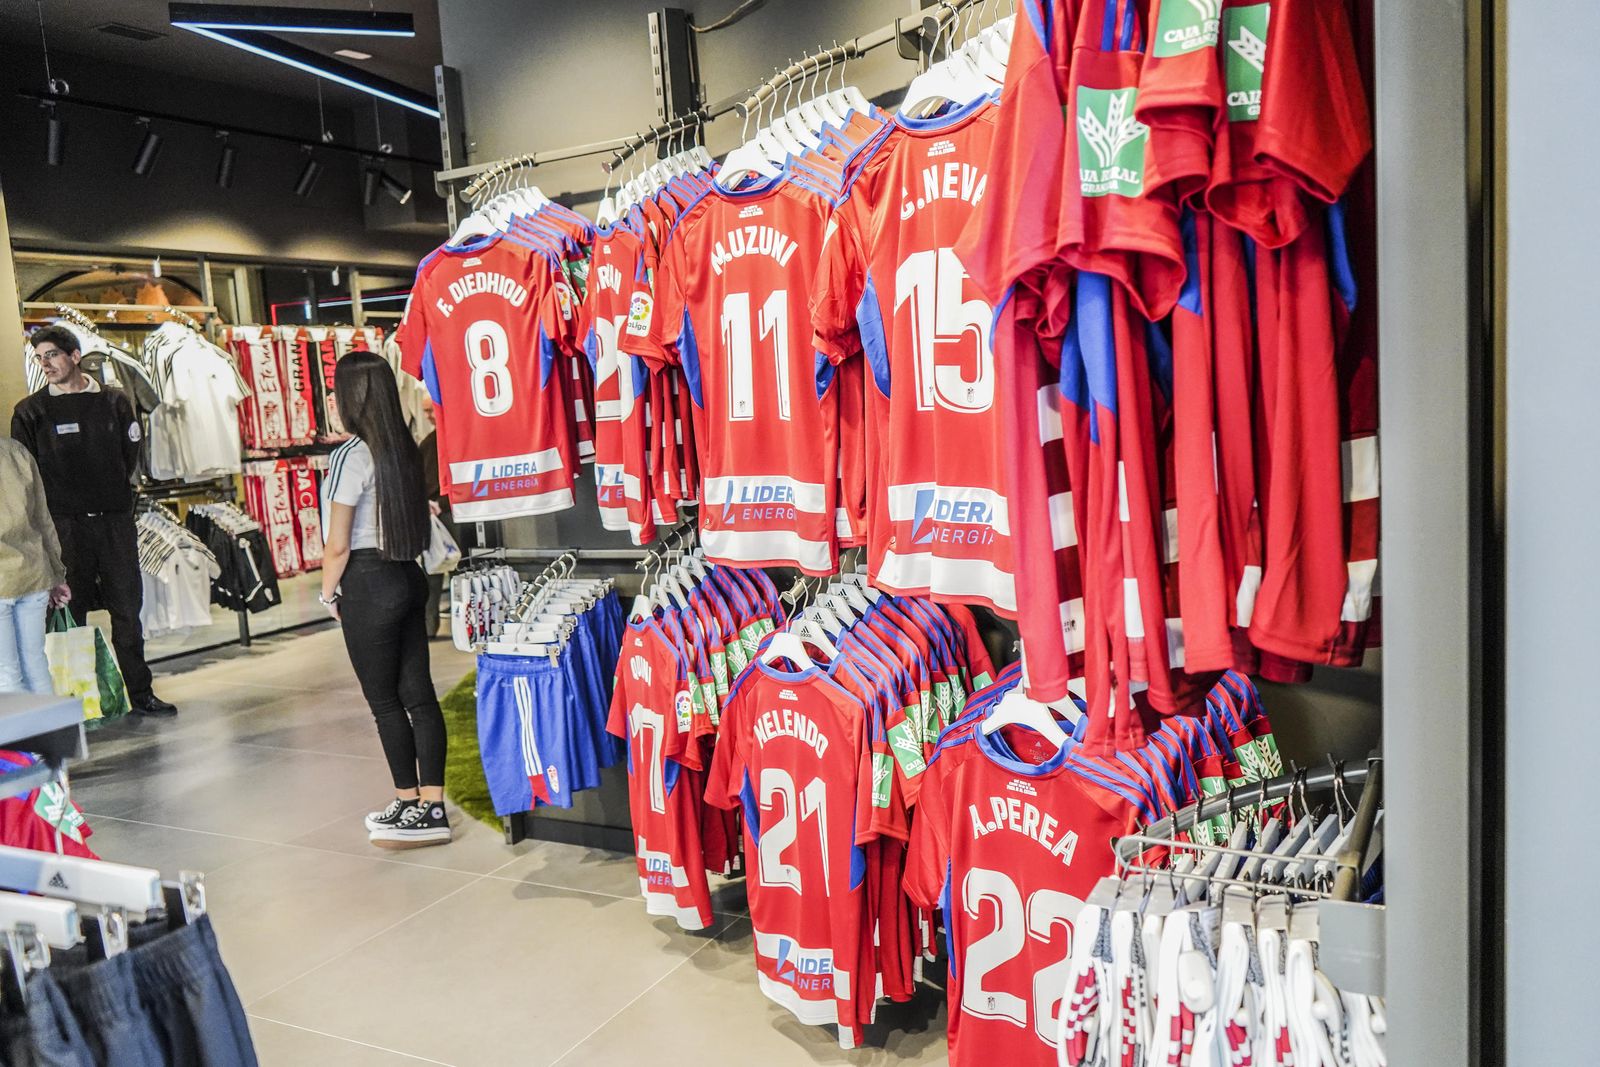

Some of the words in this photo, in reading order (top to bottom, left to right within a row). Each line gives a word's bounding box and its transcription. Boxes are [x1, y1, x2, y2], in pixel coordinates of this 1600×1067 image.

[1164, 25, 1200, 43] CAJA
[711, 225, 798, 276] M.UZUNI
[436, 297, 454, 318] F.
[448, 272, 527, 307] DIEDHIOU
[720, 290, 791, 422] 11
[893, 247, 995, 414] 15
[290, 343, 305, 392] GRAN
[464, 320, 514, 417] 8
[492, 462, 537, 478] LIDERA
[753, 708, 829, 760] MELENDO
[758, 768, 830, 897] 21
[969, 796, 1079, 867] A.PEREA
[961, 867, 1085, 1049] 22
